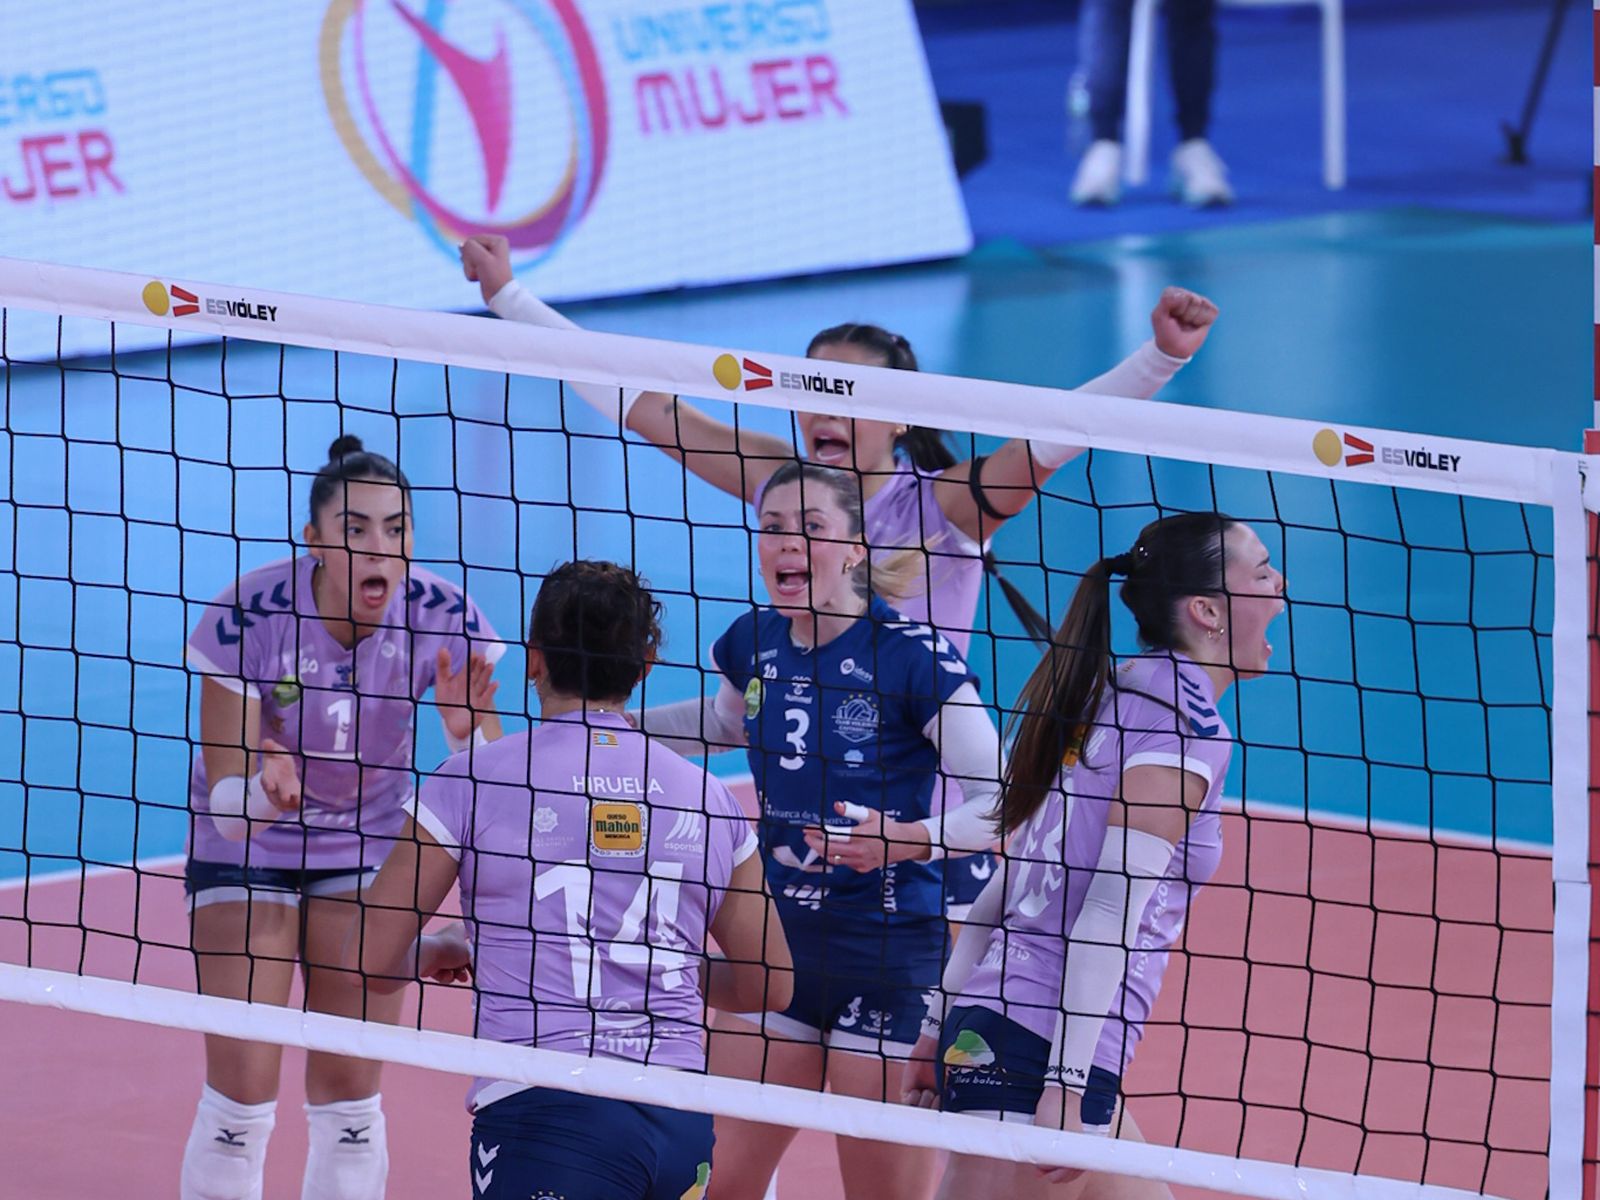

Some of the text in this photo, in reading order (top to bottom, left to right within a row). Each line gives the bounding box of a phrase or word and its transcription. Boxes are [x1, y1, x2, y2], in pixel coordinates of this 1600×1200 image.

[612, 0, 832, 62] UNIVERSO
[0, 68, 106, 127] RSO
[636, 56, 850, 133] MUJER
[206, 297, 277, 322] ESVÓLEY
[780, 371, 855, 396] ESVÓLEY
[1382, 446, 1460, 472] ESVÓLEY
[327, 699, 351, 751] 1
[780, 708, 810, 770] 3
[573, 775, 664, 794] HIRUELA
[533, 859, 687, 999] 14
[838, 996, 862, 1027] 3
